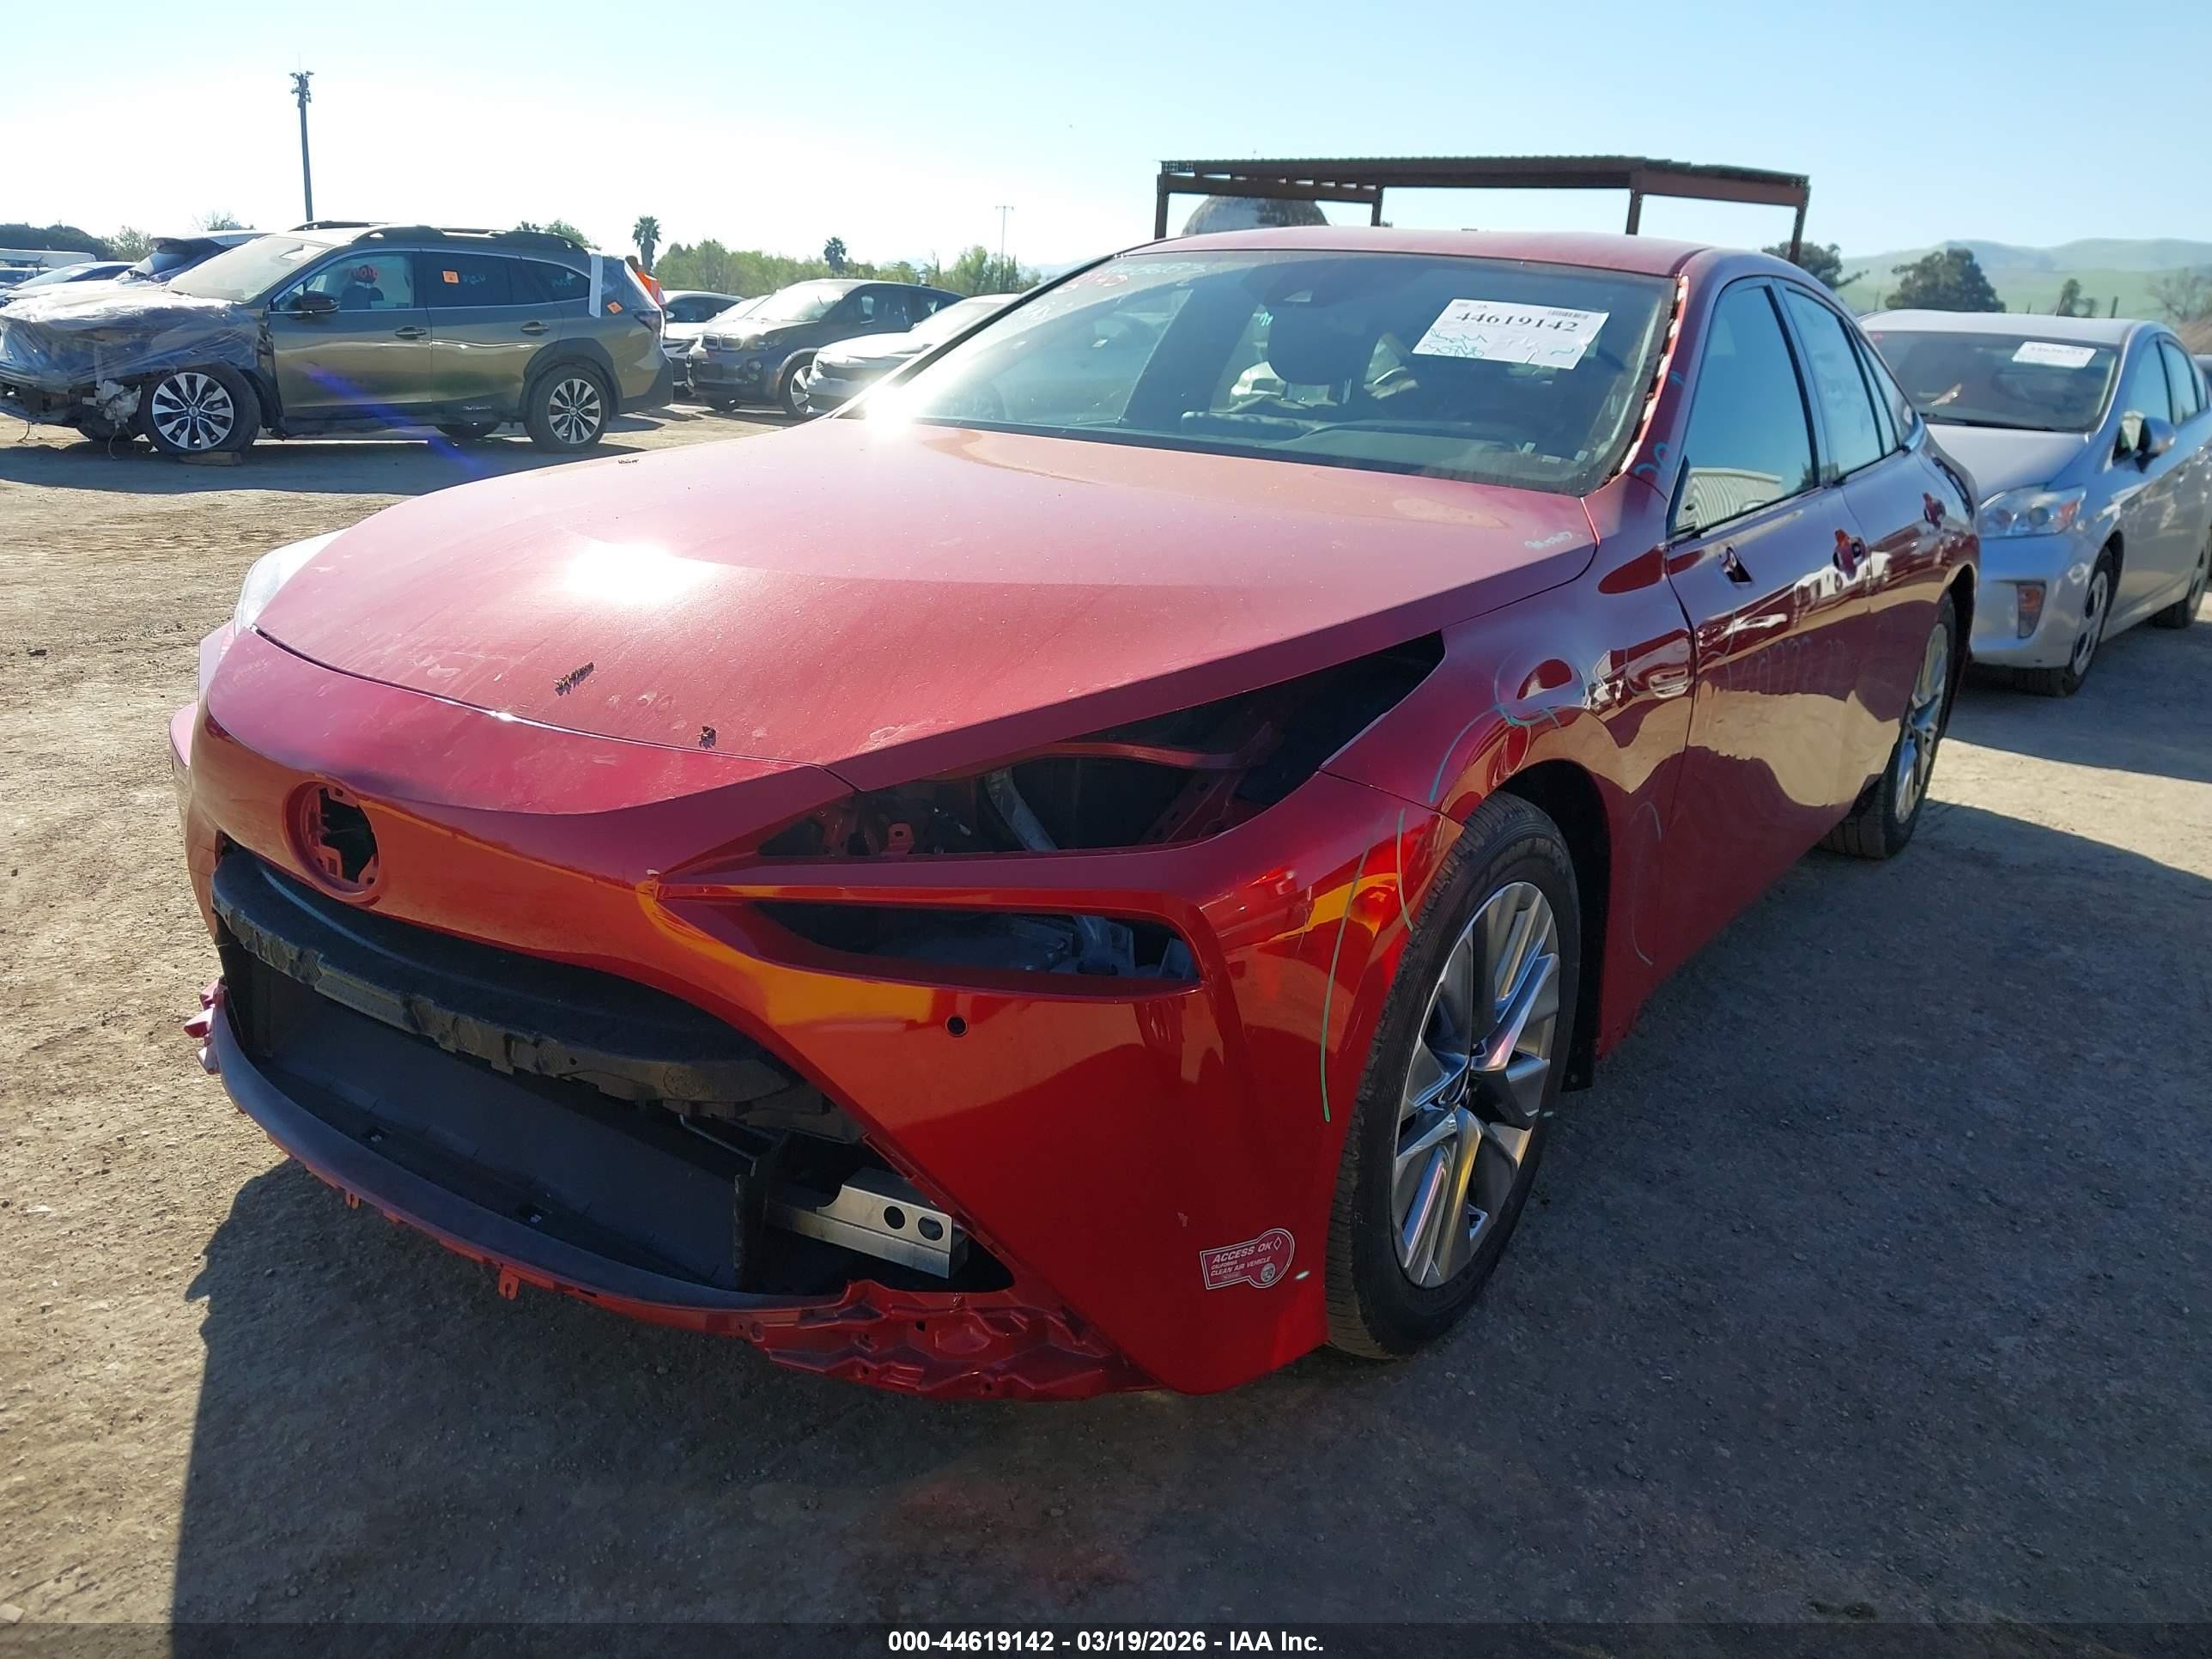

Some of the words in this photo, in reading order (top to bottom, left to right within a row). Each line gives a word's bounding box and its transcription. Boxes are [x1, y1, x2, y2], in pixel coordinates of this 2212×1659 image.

[1456, 312, 1579, 332] 44619142
[1212, 1246, 1255, 1263] ACCESS
[1258, 1241, 1273, 1252] OK
[1211, 1267, 1232, 1277] CLEAN
[1234, 1263, 1245, 1272] AIR
[1247, 1255, 1272, 1268] VEHICLE
[1212, 1260, 1237, 1270] CALIFORNIA
